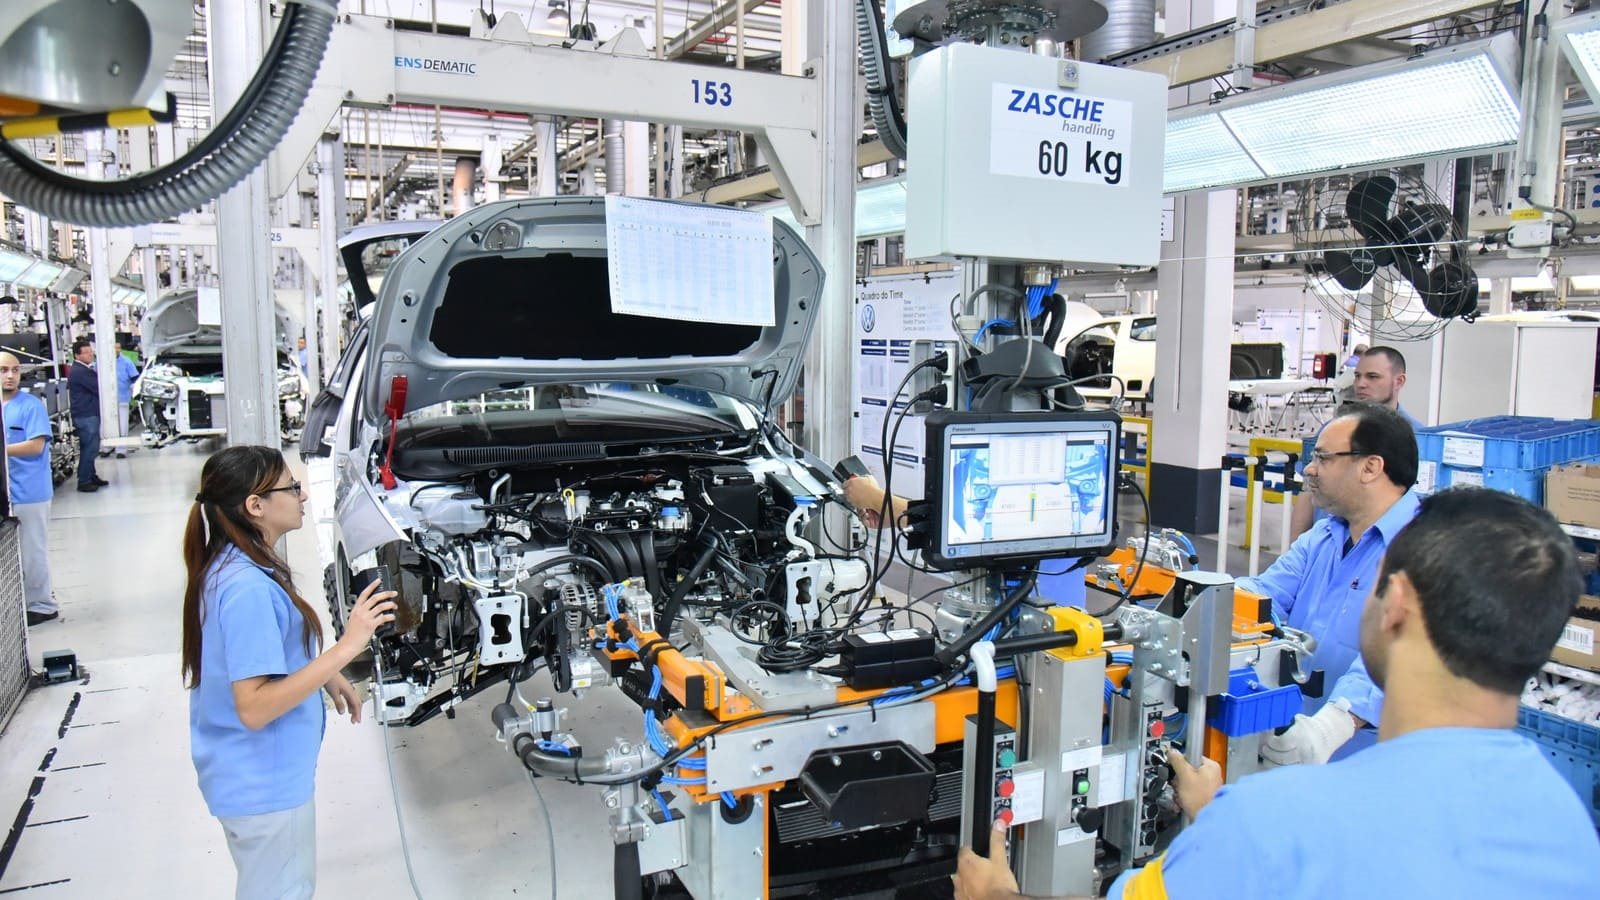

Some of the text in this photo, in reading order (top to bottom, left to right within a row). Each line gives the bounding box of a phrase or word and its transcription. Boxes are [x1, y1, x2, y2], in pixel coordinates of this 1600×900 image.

[691, 79, 733, 107] 153
[1007, 89, 1105, 122] ZASCHE
[1061, 120, 1116, 140] handling
[1038, 139, 1123, 185] 60 kg
[861, 290, 903, 300] Quadro do Time
